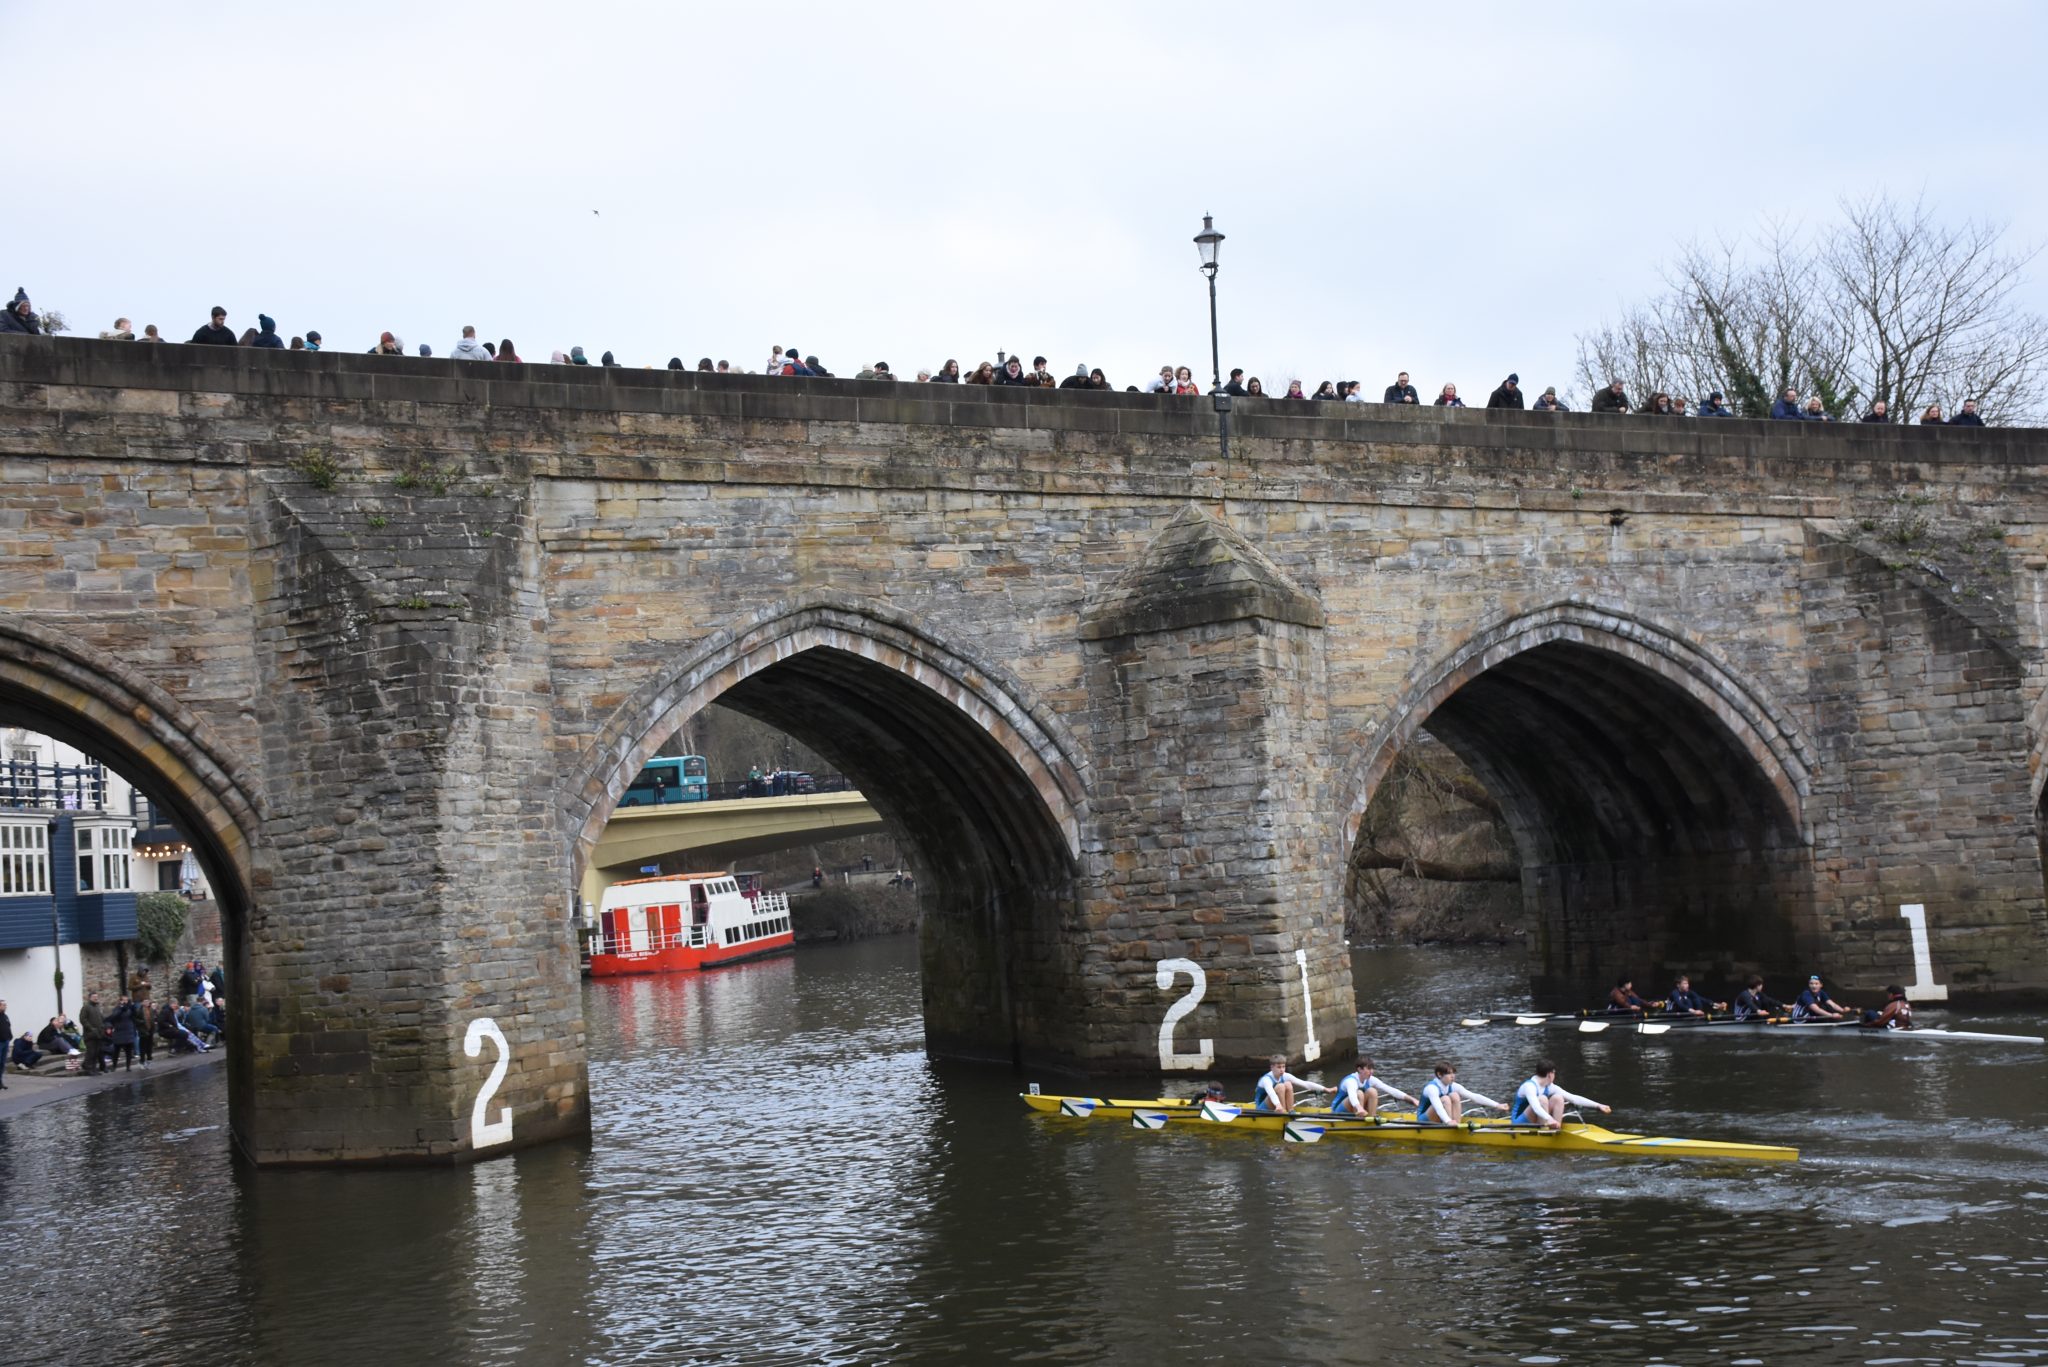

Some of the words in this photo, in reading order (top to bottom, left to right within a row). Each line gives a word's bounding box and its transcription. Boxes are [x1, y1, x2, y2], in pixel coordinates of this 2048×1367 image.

[1296, 949, 1321, 1062] 1
[1900, 904, 1948, 1001] 1
[1156, 957, 1215, 1070] 2
[464, 1017, 513, 1149] 2
